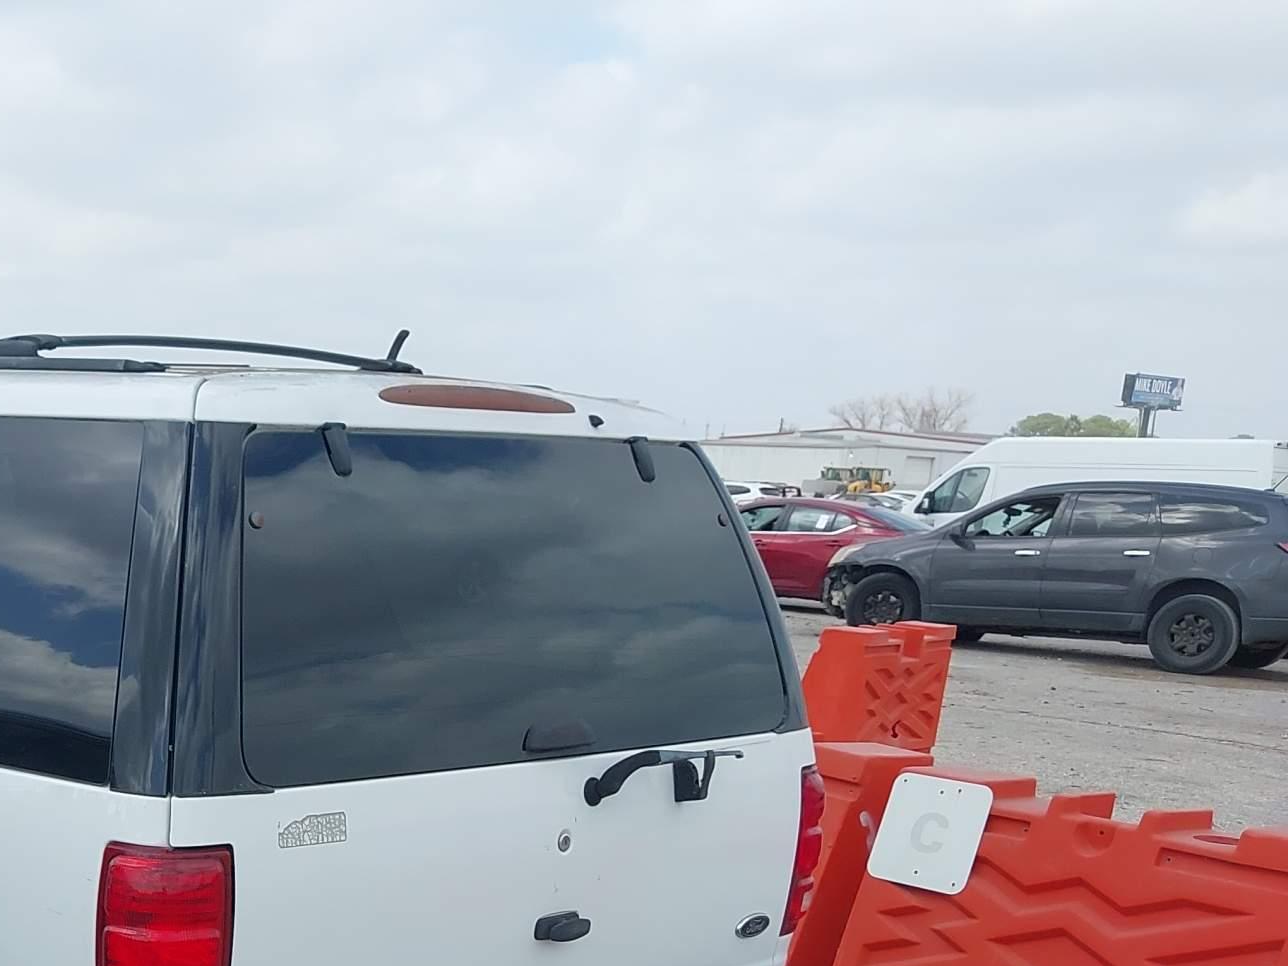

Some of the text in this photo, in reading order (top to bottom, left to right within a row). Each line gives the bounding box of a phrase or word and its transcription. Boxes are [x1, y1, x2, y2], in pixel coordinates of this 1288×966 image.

[1135, 377, 1172, 394] MIKE DOYLE
[910, 812, 950, 853] C
